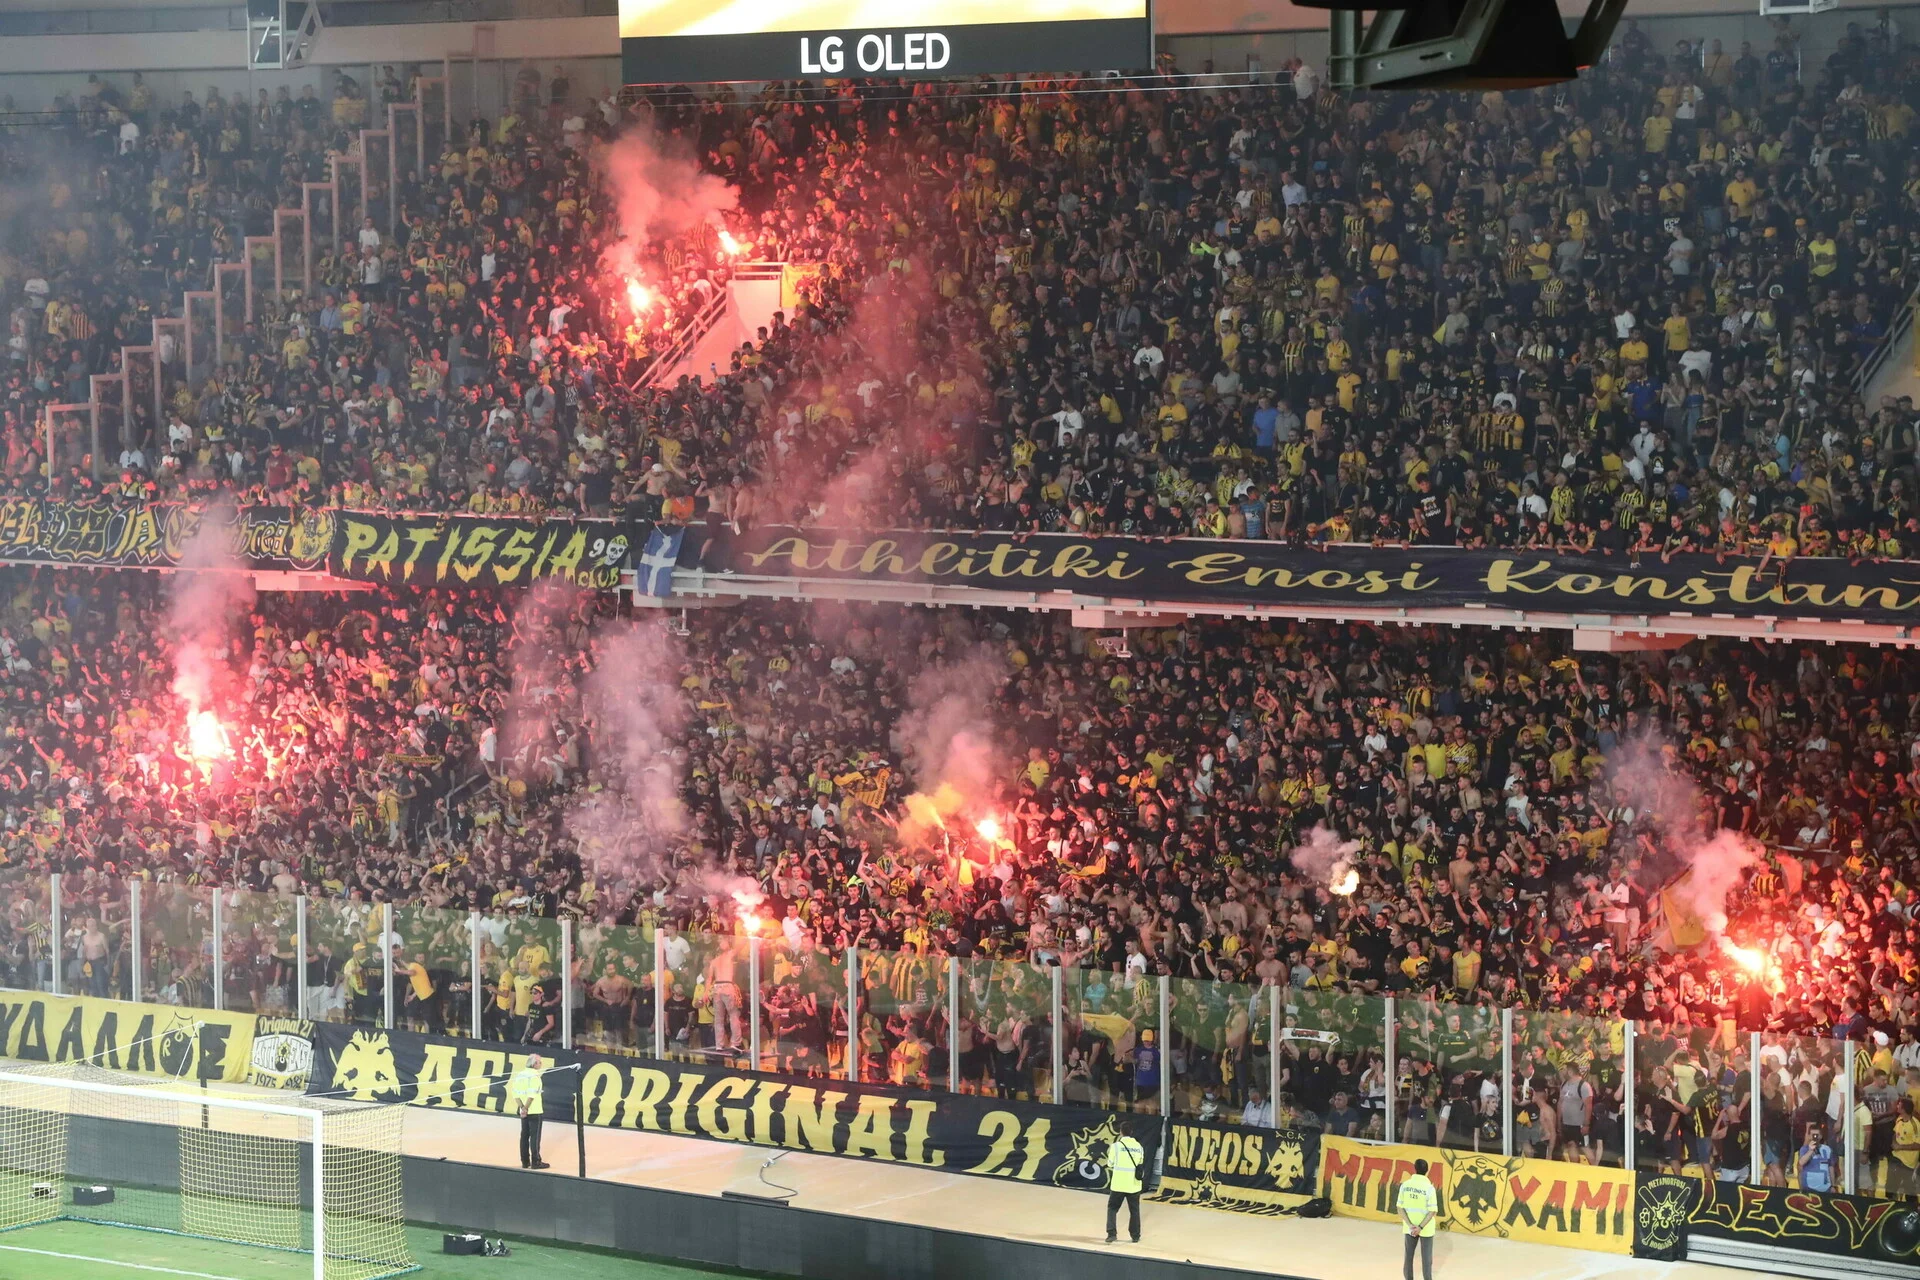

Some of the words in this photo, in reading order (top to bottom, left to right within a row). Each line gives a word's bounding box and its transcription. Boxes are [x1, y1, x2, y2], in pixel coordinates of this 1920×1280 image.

[800, 37, 843, 74] LG
[856, 32, 950, 72] OLED
[341, 518, 590, 586] PATISSIA
[1167, 552, 1439, 594] Enosi
[258, 1016, 301, 1035] Original
[300, 1020, 315, 1038] 21
[255, 1072, 276, 1088] 1975
[574, 1062, 946, 1168] ORIGINAL
[962, 1110, 1051, 1181] 21
[1168, 1125, 1264, 1176] NEOS
[1647, 1177, 1687, 1190] METAMORFOSI
